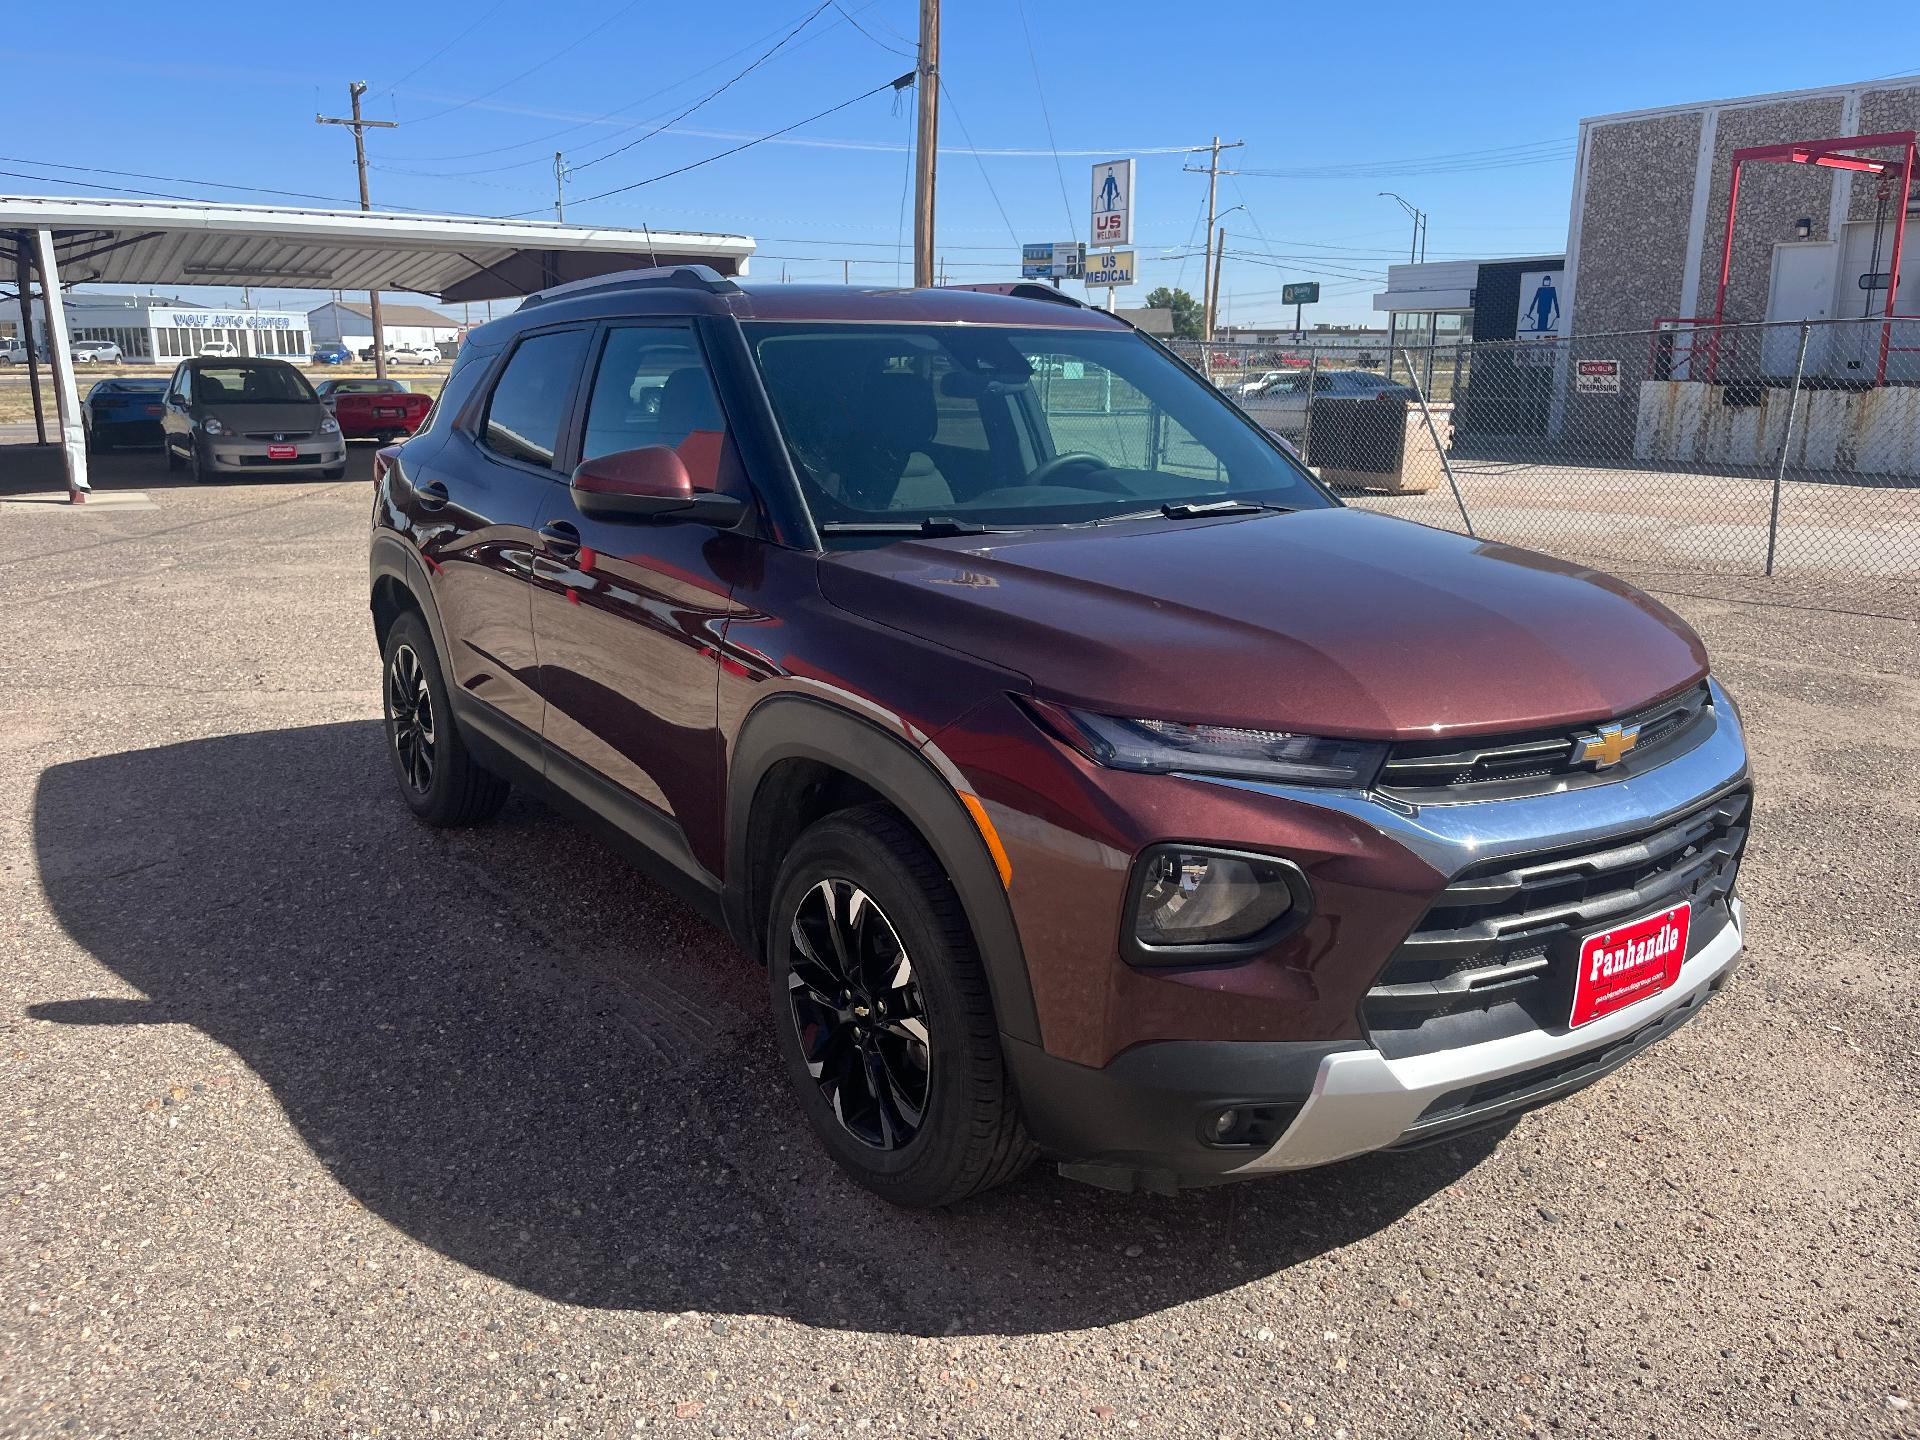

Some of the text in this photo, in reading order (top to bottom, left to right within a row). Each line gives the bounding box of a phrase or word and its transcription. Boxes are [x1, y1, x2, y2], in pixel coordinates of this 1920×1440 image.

[1097, 215, 1121, 230] US
[1097, 230, 1121, 239] WELDING
[1102, 256, 1116, 268] US
[1085, 270, 1131, 283] MEDICAL
[173, 314, 290, 329] WOLF AUTO CENTER
[1579, 384, 1617, 392] TRESPASSING
[1590, 923, 1679, 981] Panhandle
